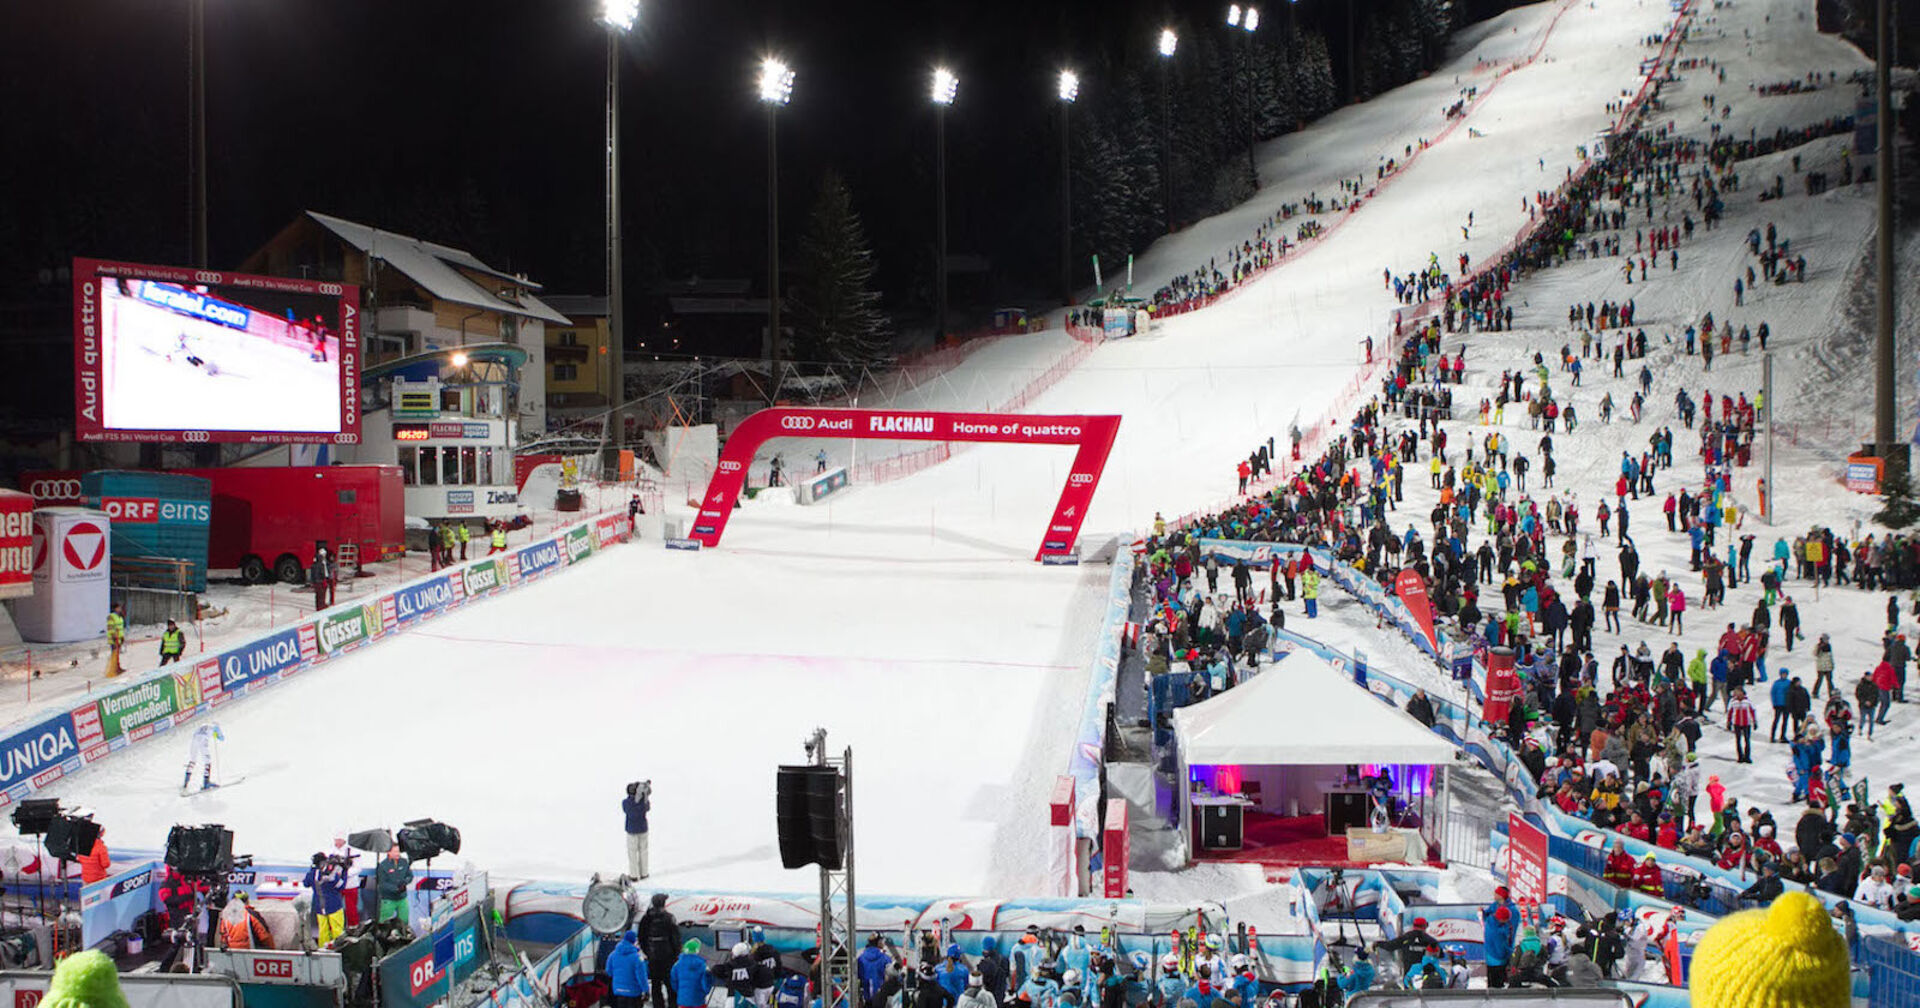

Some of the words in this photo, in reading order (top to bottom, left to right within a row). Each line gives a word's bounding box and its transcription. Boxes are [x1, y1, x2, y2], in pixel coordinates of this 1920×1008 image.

[81, 281, 99, 365] quattro
[345, 303, 357, 348] Audi
[82, 370, 97, 421] Audi
[344, 352, 356, 425] quattro
[818, 418, 853, 430] Audi
[870, 416, 934, 433] FLACHAU
[953, 421, 997, 434] Home
[1001, 422, 1018, 434] of
[1022, 424, 1081, 438] quattro
[105, 501, 156, 518] ORF
[161, 502, 209, 521] eins
[415, 582, 453, 610] UNIQA
[319, 616, 362, 653] Gösser
[248, 639, 299, 675] UNIQA
[101, 681, 161, 716] Vernünftig
[120, 695, 172, 731] genießen!
[0, 726, 74, 782] UNIQA
[121, 872, 151, 894] SPORT
[228, 872, 253, 884] ORT
[454, 933, 474, 962] ins
[255, 962, 290, 974] ORF
[412, 960, 437, 987] OR
[731, 967, 750, 981] ITA
